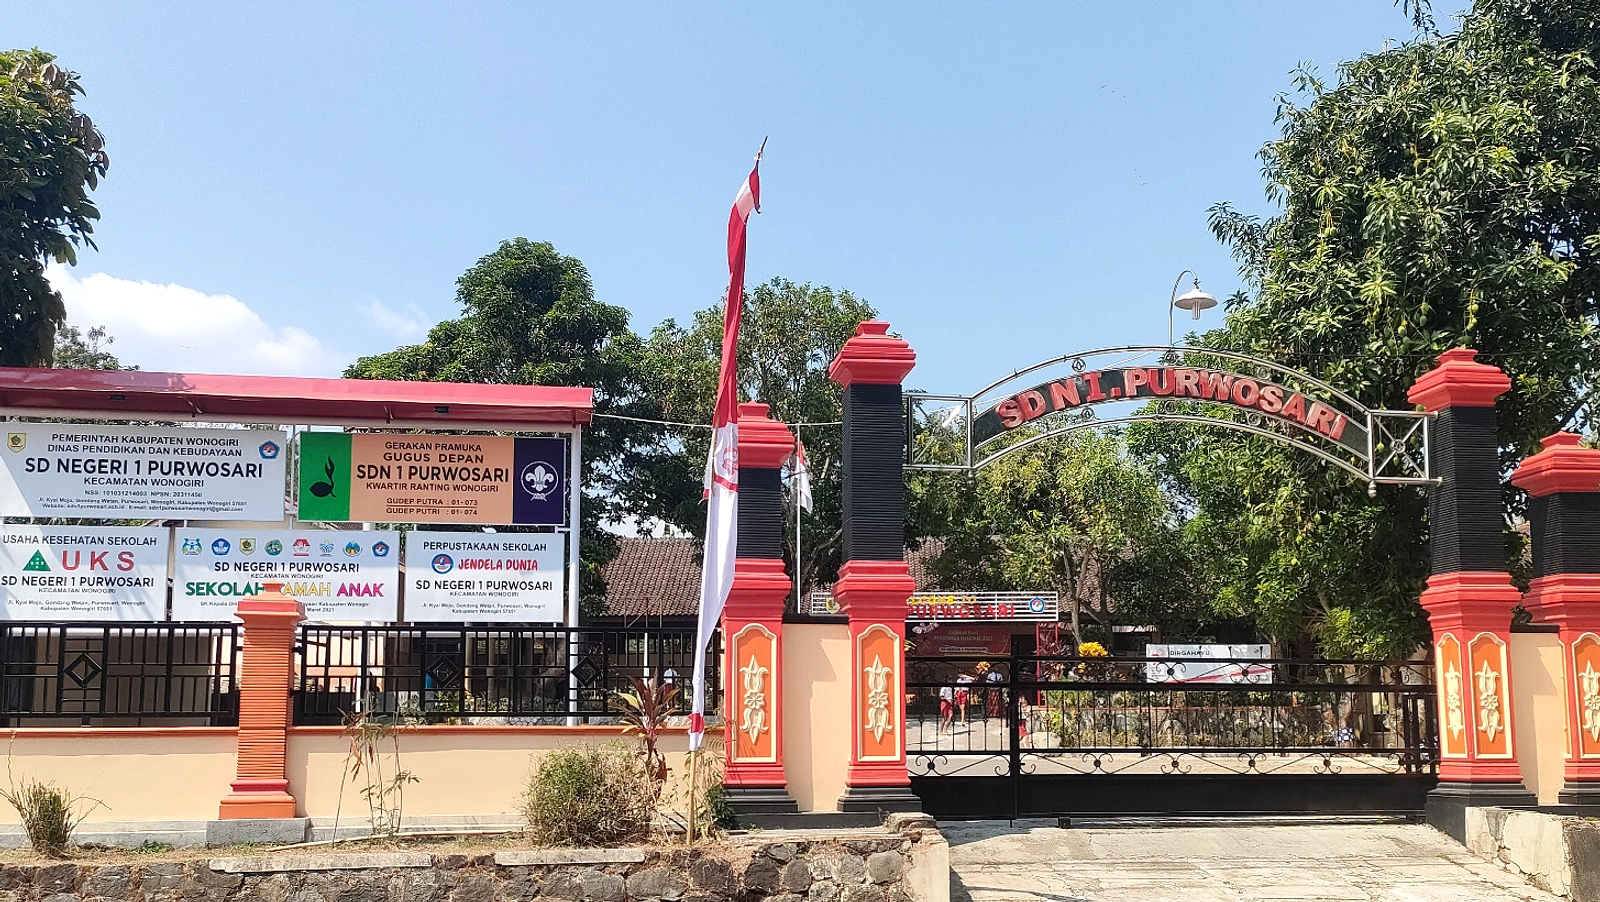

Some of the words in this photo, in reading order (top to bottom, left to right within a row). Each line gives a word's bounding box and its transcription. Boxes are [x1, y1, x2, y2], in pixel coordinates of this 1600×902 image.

[1123, 368, 1348, 441] PURWOSARI
[52, 434, 118, 444] PEMERINTAH
[121, 435, 184, 446] KABUPATEN
[186, 437, 239, 447] WONOGIRI
[48, 444, 80, 453] DINAS
[82, 445, 146, 455] PENDIDIKAN
[148, 446, 170, 455] DAN
[173, 447, 242, 457] KEBUDAYAAN
[385, 442, 432, 451] GERAKAN
[435, 442, 482, 452] PRAMUKA
[383, 452, 431, 462] GUGUS
[438, 454, 484, 464] DEPAN
[25, 457, 50, 473] SD
[57, 458, 128, 475] NEGERI
[134, 460, 141, 475] 1
[148, 460, 263, 478] PURWOSARI
[356, 464, 391, 480] SDN
[396, 466, 402, 480] 1
[408, 466, 509, 483] PURWOSARI
[84, 477, 148, 486] KECAMATAN
[150, 478, 204, 488] WONOGIRI
[366, 482, 408, 491] KWARTIR
[410, 483, 450, 492] RANTING
[452, 484, 498, 493] WONOGIRI
[3, 535, 39, 544] USAHA
[42, 535, 104, 545] KESEHATAN
[107, 536, 157, 546] SEKOLAH
[423, 542, 499, 551] PERPUSTAKAAN
[502, 543, 547, 551] SEKOLAH
[214, 562, 230, 572] SD
[234, 562, 277, 572] NEGERI
[281, 563, 285, 572] 1
[289, 562, 359, 573] PURWOSARI
[458, 558, 502, 571] JENDELA
[506, 559, 538, 571] DUNIA
[1, 576, 18, 586] SD
[22, 576, 67, 586] NEGERI
[72, 577, 75, 586] 1
[80, 577, 154, 587] PURWOSARI
[416, 580, 430, 590] SD
[434, 580, 475, 590] NEGERI
[479, 581, 482, 590] 1
[486, 581, 552, 591] PURWOSARI
[185, 582, 265, 596] SEKOLAH
[283, 582, 331, 597] AMAH
[337, 583, 385, 598] ANAK
